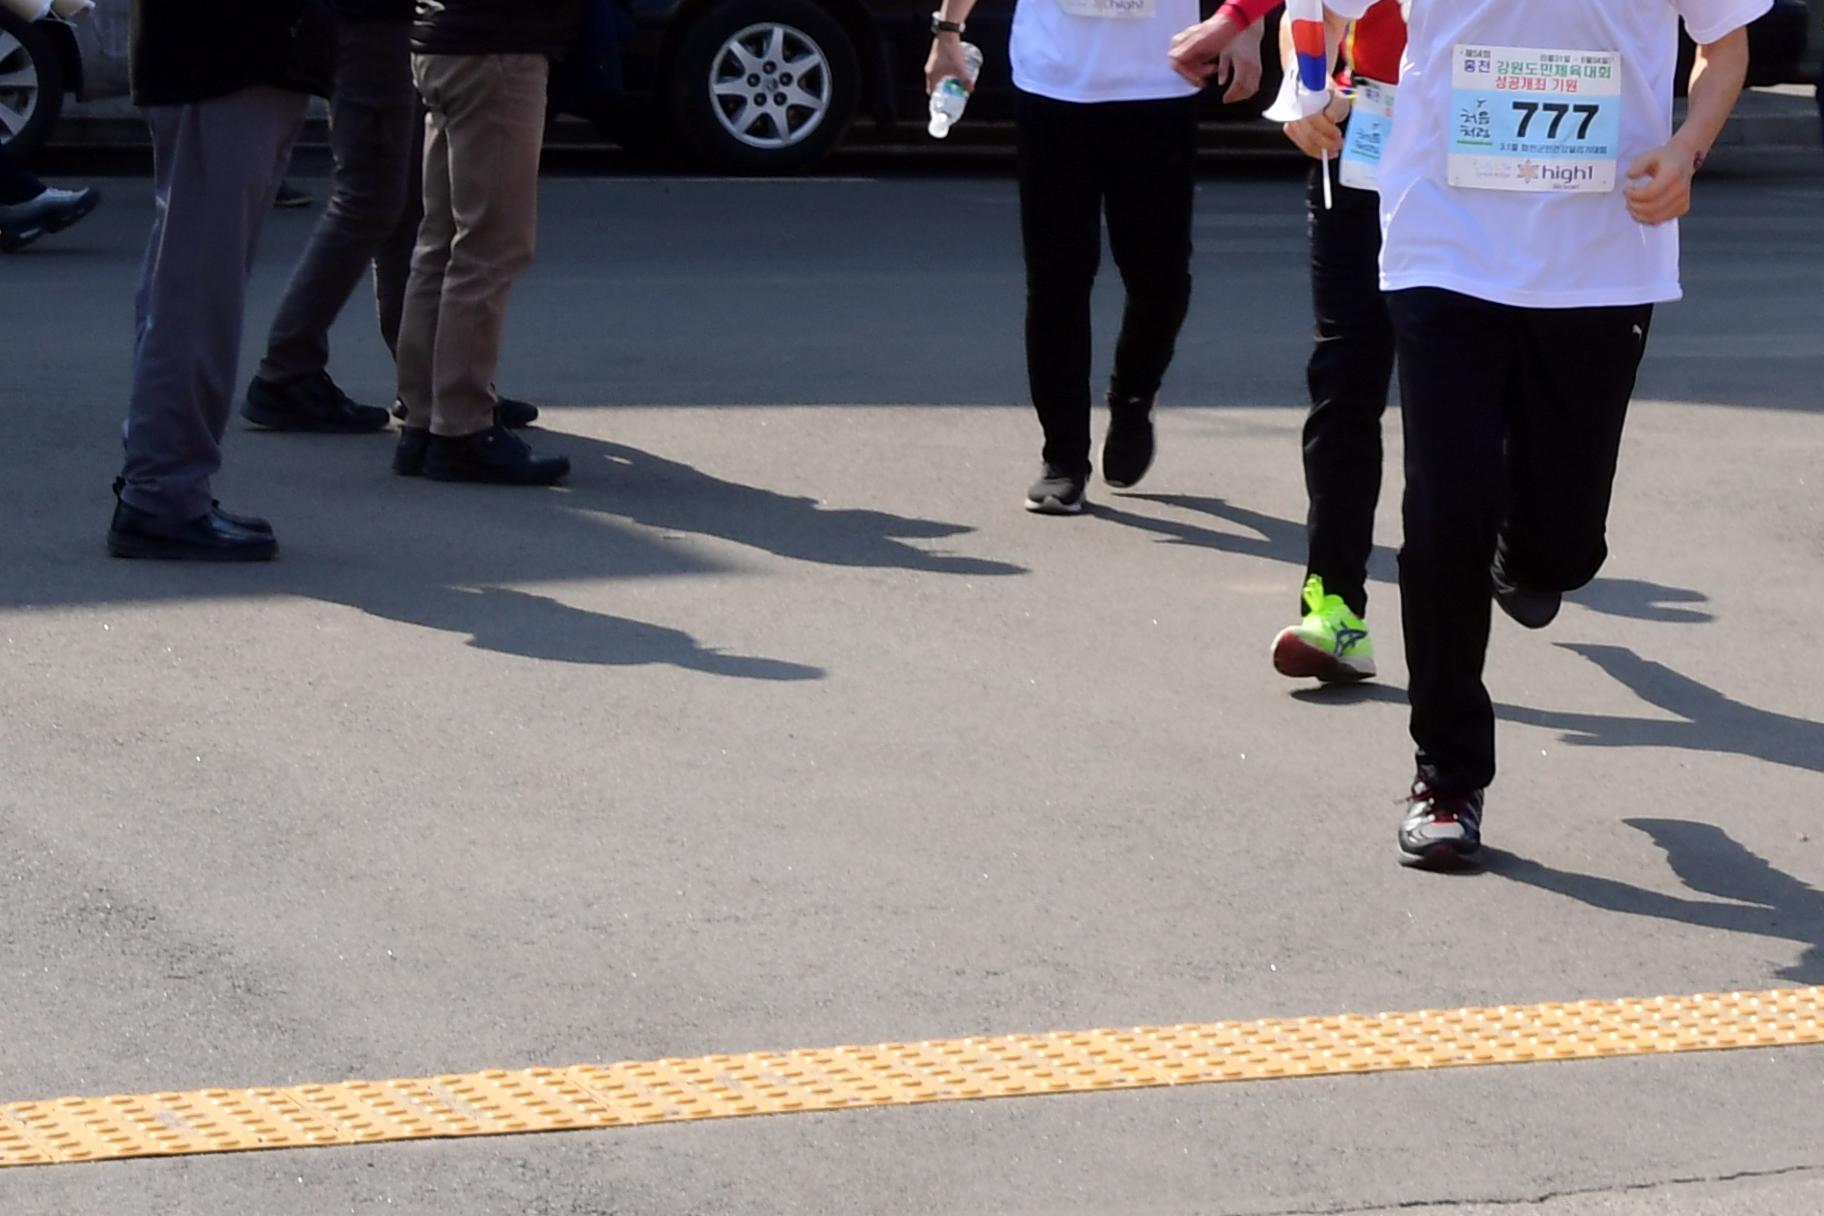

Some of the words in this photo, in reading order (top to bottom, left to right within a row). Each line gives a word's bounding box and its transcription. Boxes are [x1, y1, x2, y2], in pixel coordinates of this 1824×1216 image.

[1464, 59, 1491, 74] 홍천
[1497, 61, 1612, 80] 강원도민체육대회
[1494, 75, 1547, 92] 성공개최
[1552, 78, 1579, 94] 기원
[1512, 101, 1600, 141] 777
[1542, 165, 1594, 184] high1
